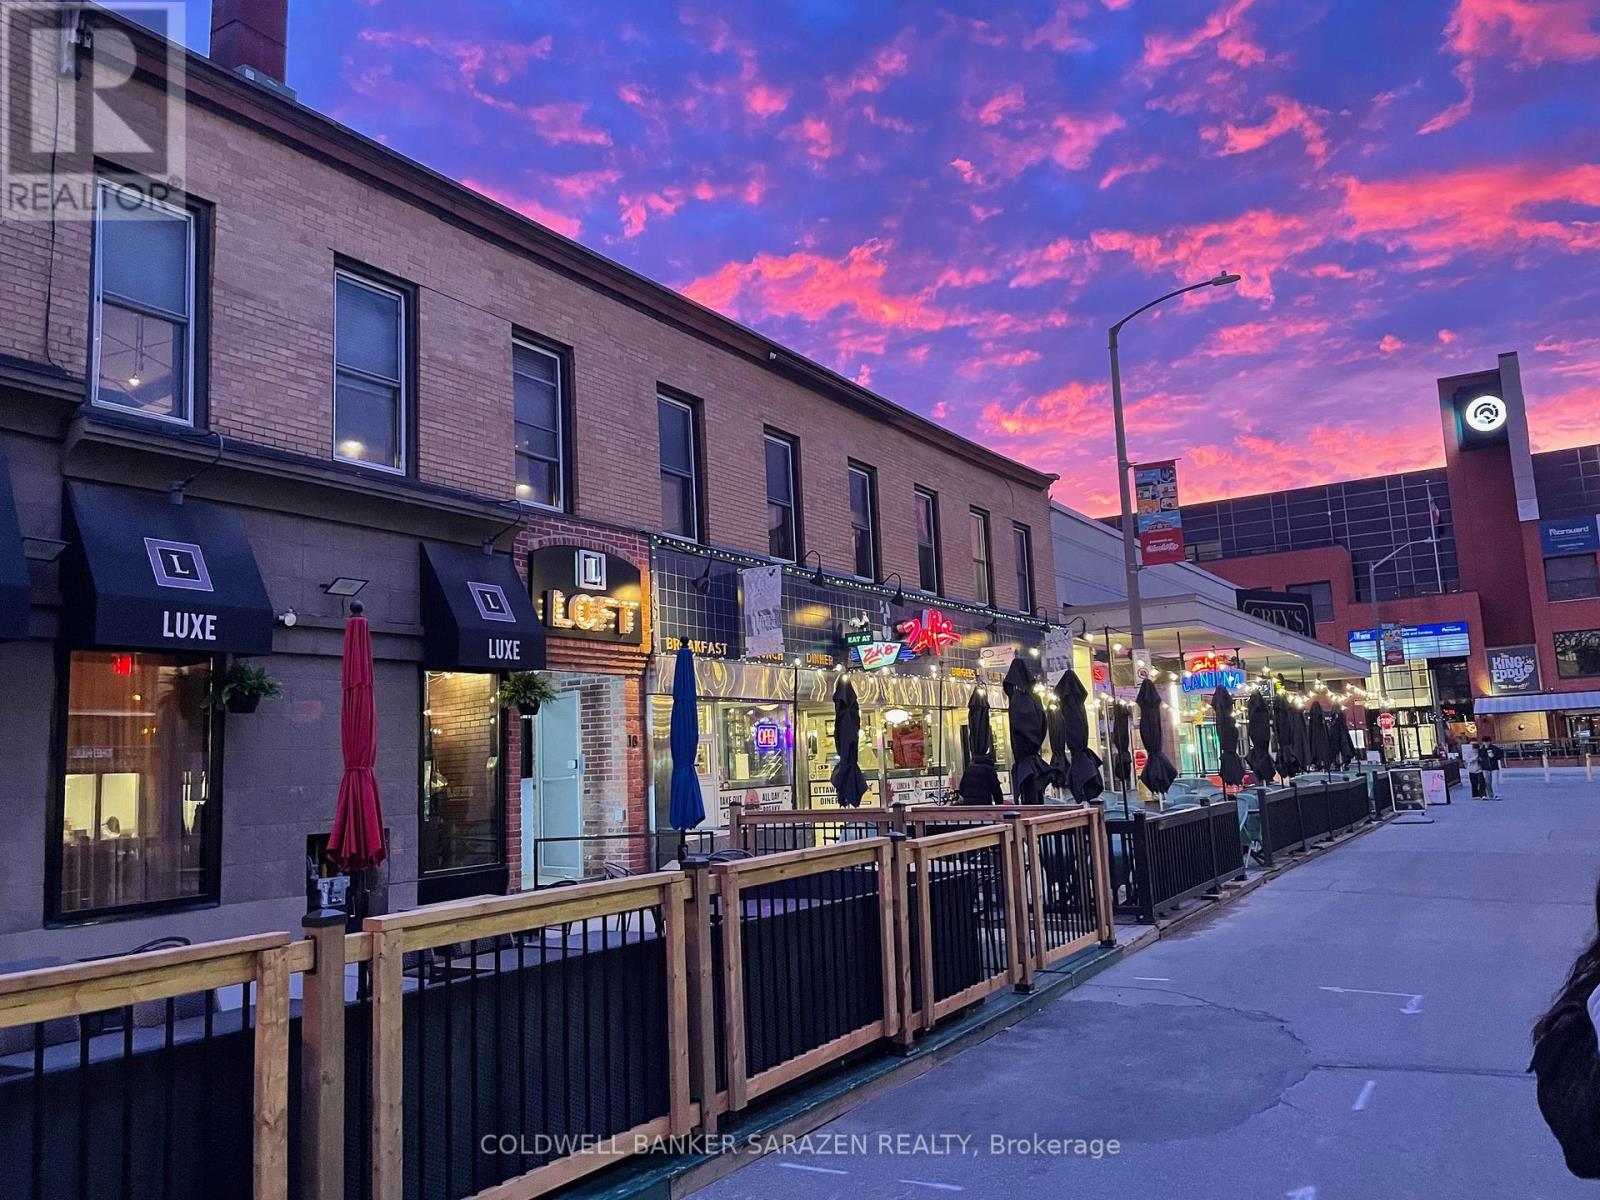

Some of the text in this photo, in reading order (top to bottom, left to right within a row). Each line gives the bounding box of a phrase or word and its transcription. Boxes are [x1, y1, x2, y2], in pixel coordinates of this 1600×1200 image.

[169, 554, 190, 574] L
[485, 593, 500, 610] L
[547, 589, 640, 635] LOFT
[163, 610, 217, 640] LUXE
[488, 638, 520, 660] LUXE
[665, 637, 728, 656] BRAKFAST
[759, 728, 776, 745] OPEN
[813, 786, 838, 795] OTTAW
